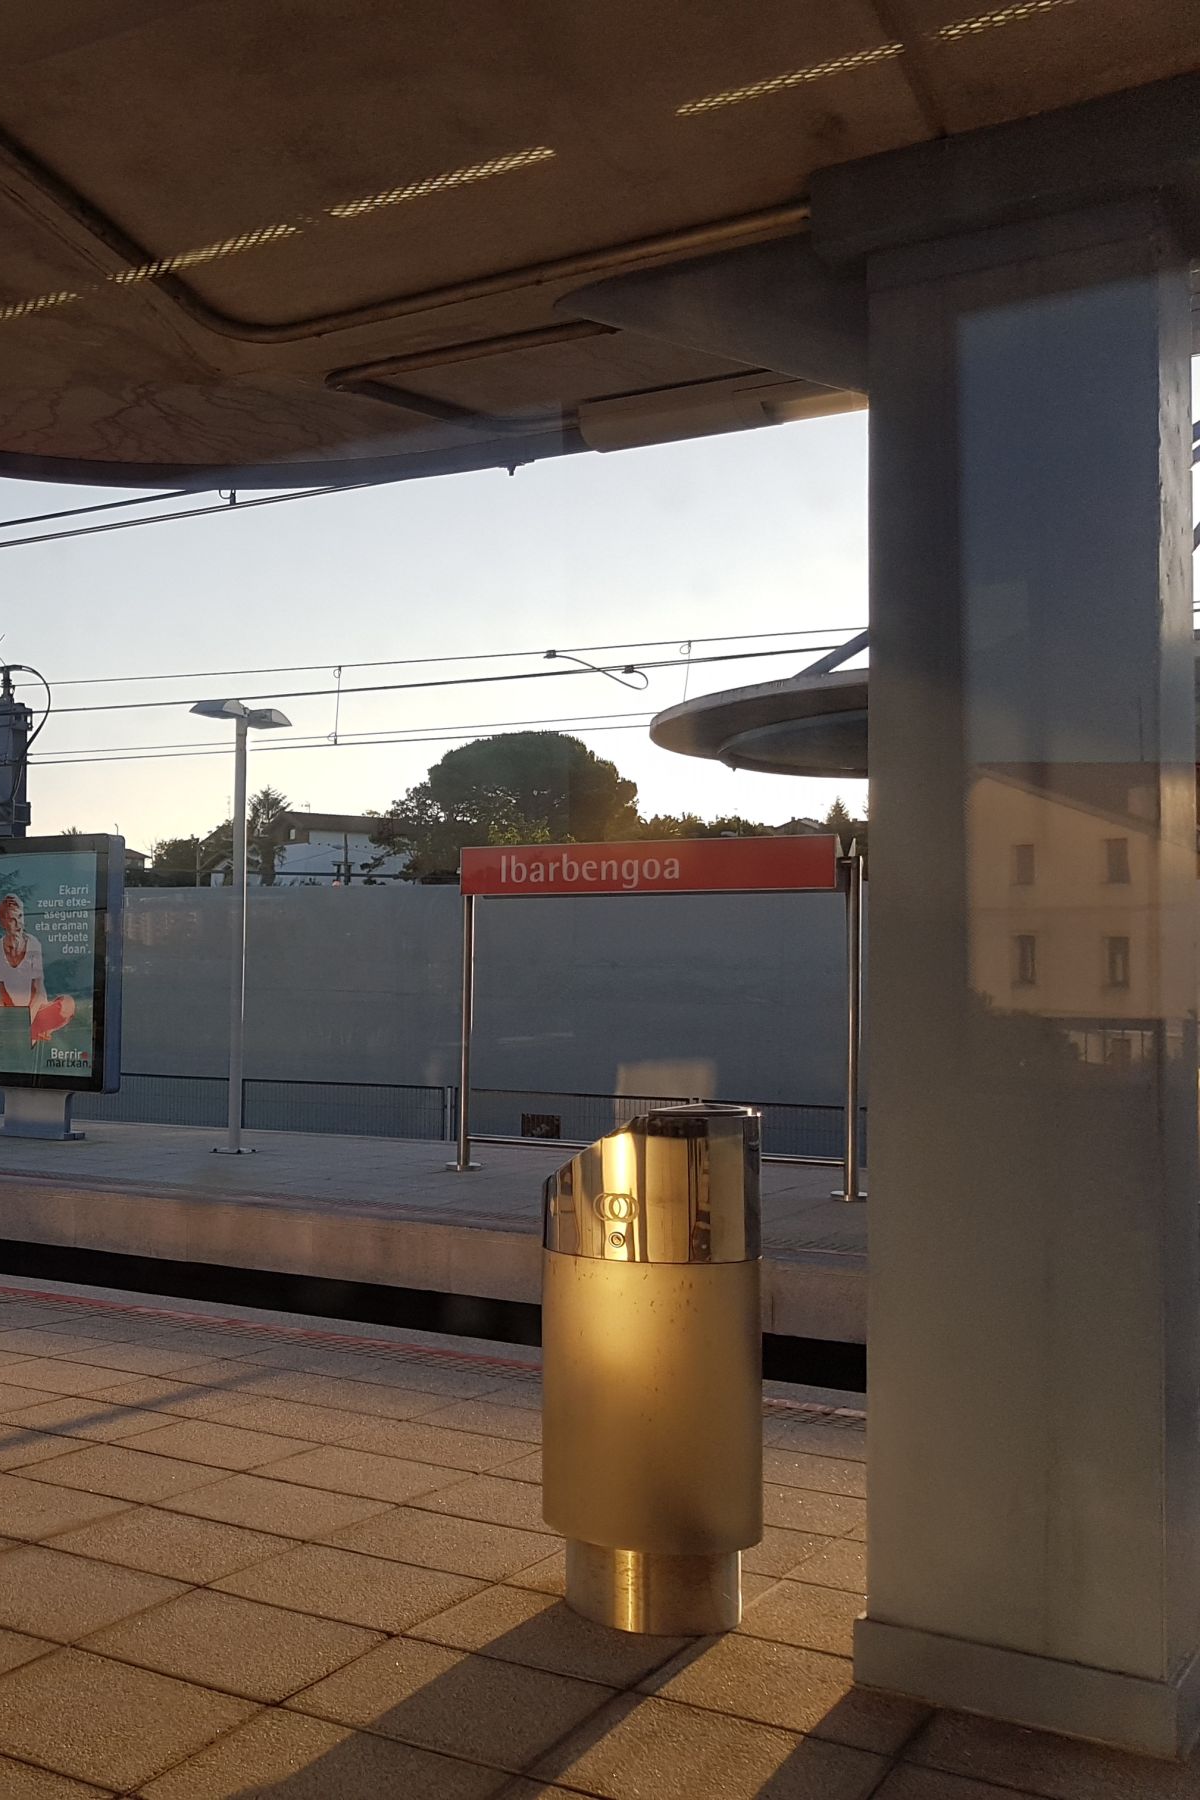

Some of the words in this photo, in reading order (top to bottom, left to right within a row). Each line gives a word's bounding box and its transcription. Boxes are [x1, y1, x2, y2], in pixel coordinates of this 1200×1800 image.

[499, 853, 680, 888] Ibarbengoa
[59, 883, 89, 895] Ekarri
[37, 899, 64, 908] zeure
[66, 897, 91, 907] etxe-
[43, 910, 89, 921] asegurua
[35, 921, 50, 931] eta
[51, 922, 89, 931] eraman
[48, 932, 89, 942] urtebete
